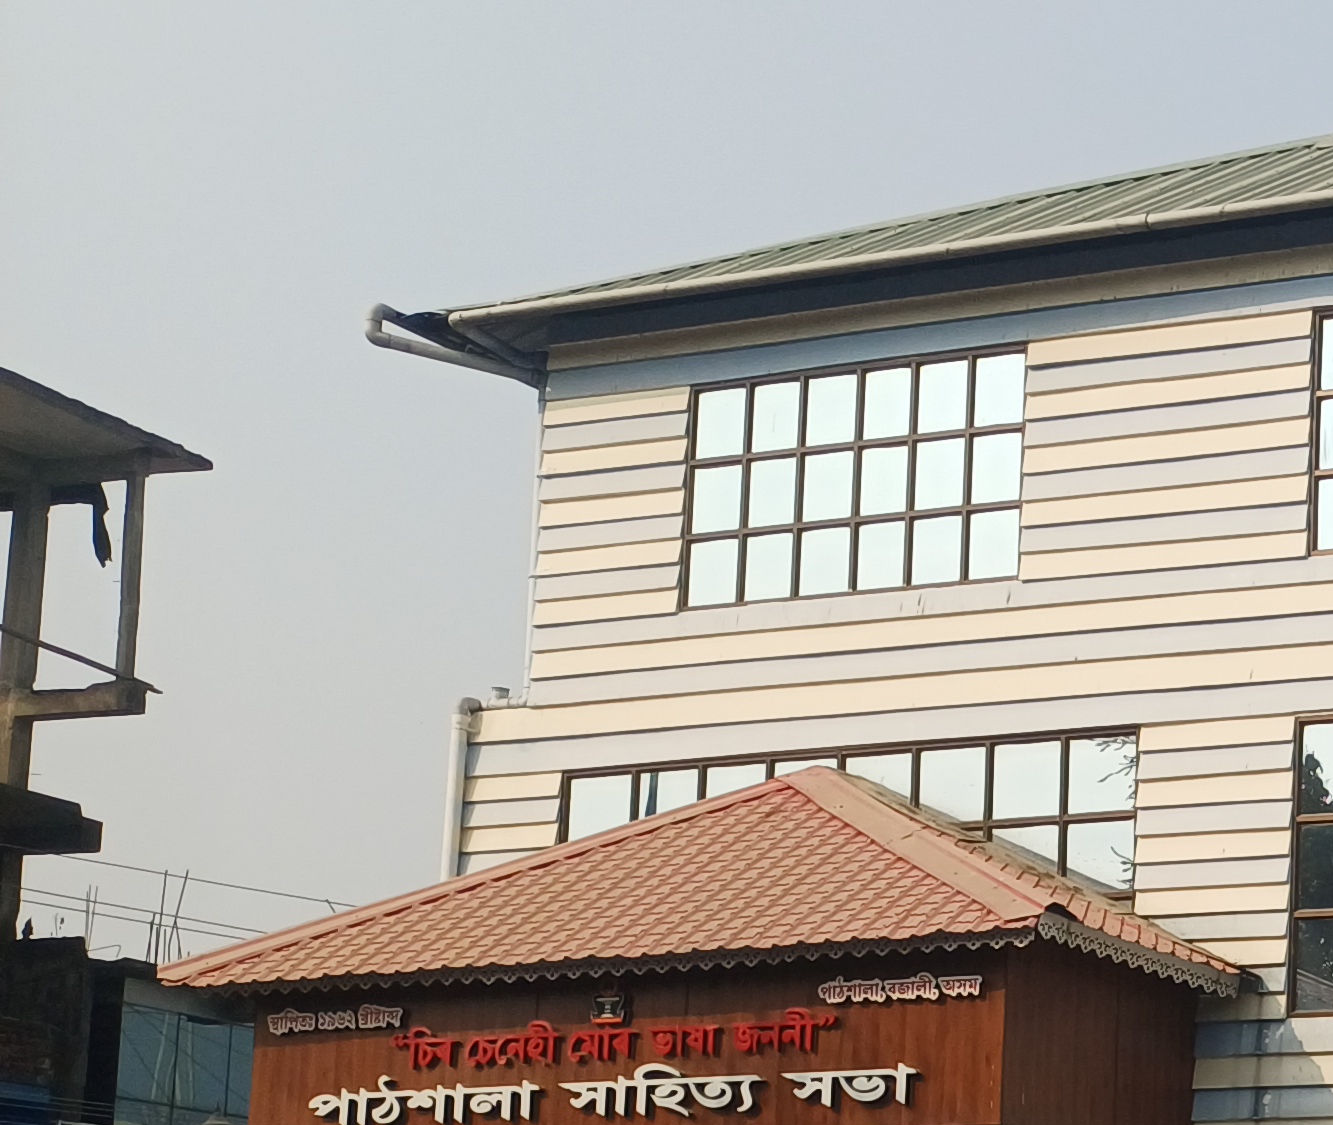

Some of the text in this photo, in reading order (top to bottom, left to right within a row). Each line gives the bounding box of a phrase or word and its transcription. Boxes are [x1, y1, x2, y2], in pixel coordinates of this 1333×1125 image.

[568, 1021, 634, 1063] মোৰ
[650, 1024, 721, 1056] ভাষা
[558, 1063, 765, 1117] সাহিত্য
[781, 1062, 920, 1107] সভা
